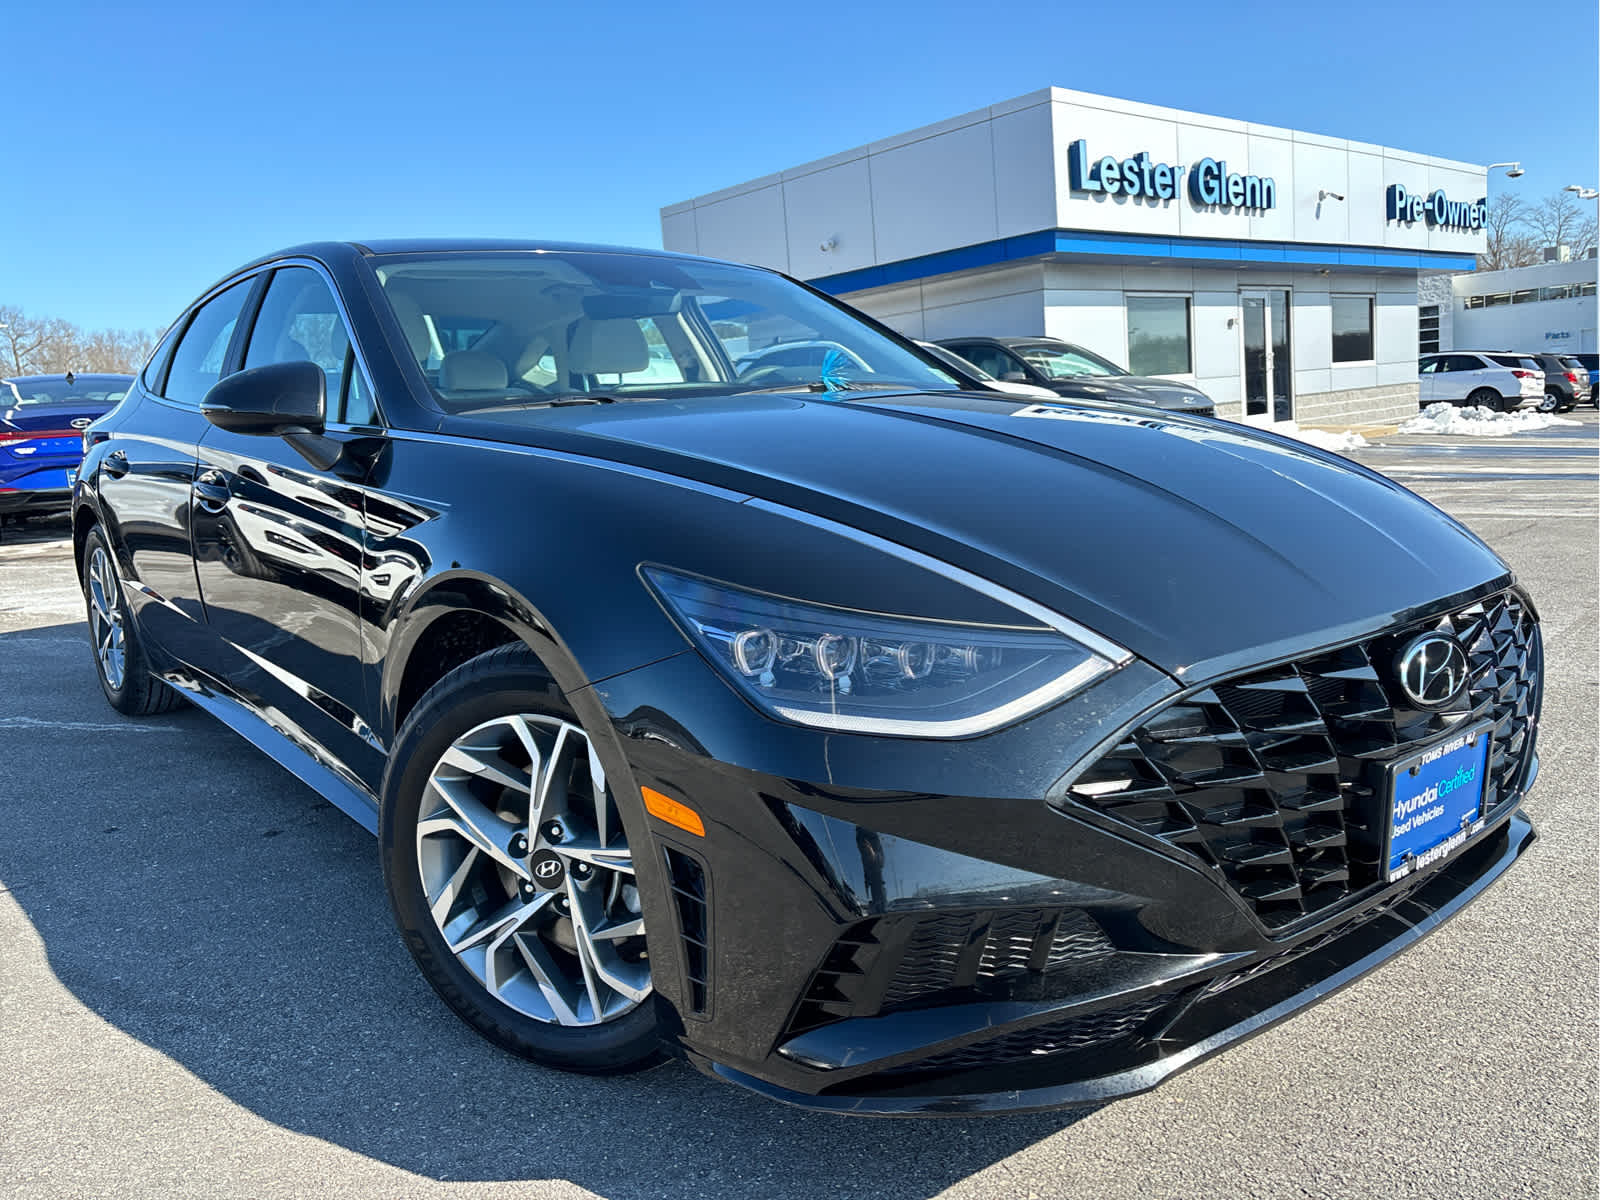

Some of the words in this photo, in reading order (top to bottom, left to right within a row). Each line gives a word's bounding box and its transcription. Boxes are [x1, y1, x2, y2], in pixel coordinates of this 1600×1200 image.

[1070, 139, 1185, 200] Lester
[1190, 157, 1276, 209] Glenn
[1388, 184, 1488, 229] Pre-Owned
[1421, 746, 1443, 766] TOMS
[1392, 783, 1438, 820] Hyundai
[1438, 763, 1475, 797] Certified
[1412, 805, 1444, 828] Vehicles
